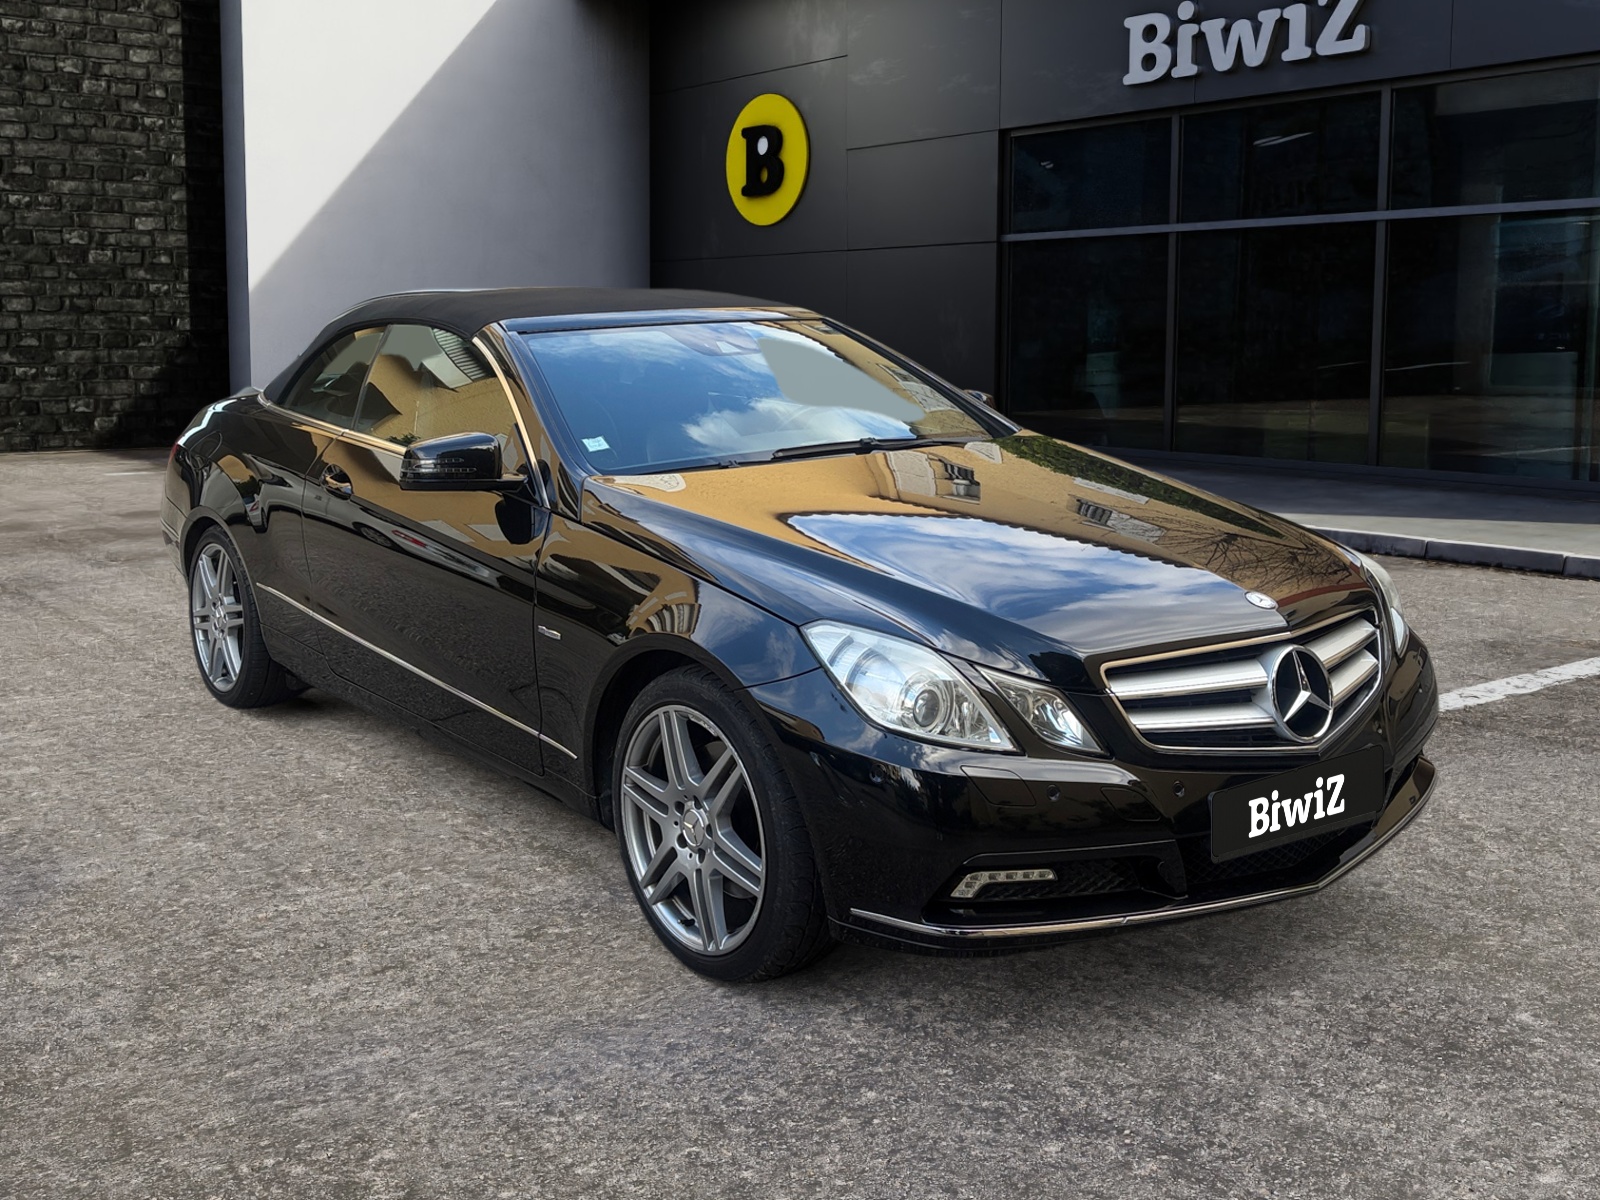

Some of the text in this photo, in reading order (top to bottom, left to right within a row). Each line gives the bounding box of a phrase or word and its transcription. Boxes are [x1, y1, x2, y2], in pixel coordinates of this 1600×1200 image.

[1122, 0, 1366, 86] BiwiZ
[741, 124, 785, 197] B
[1248, 773, 1345, 839] BiwiZ
